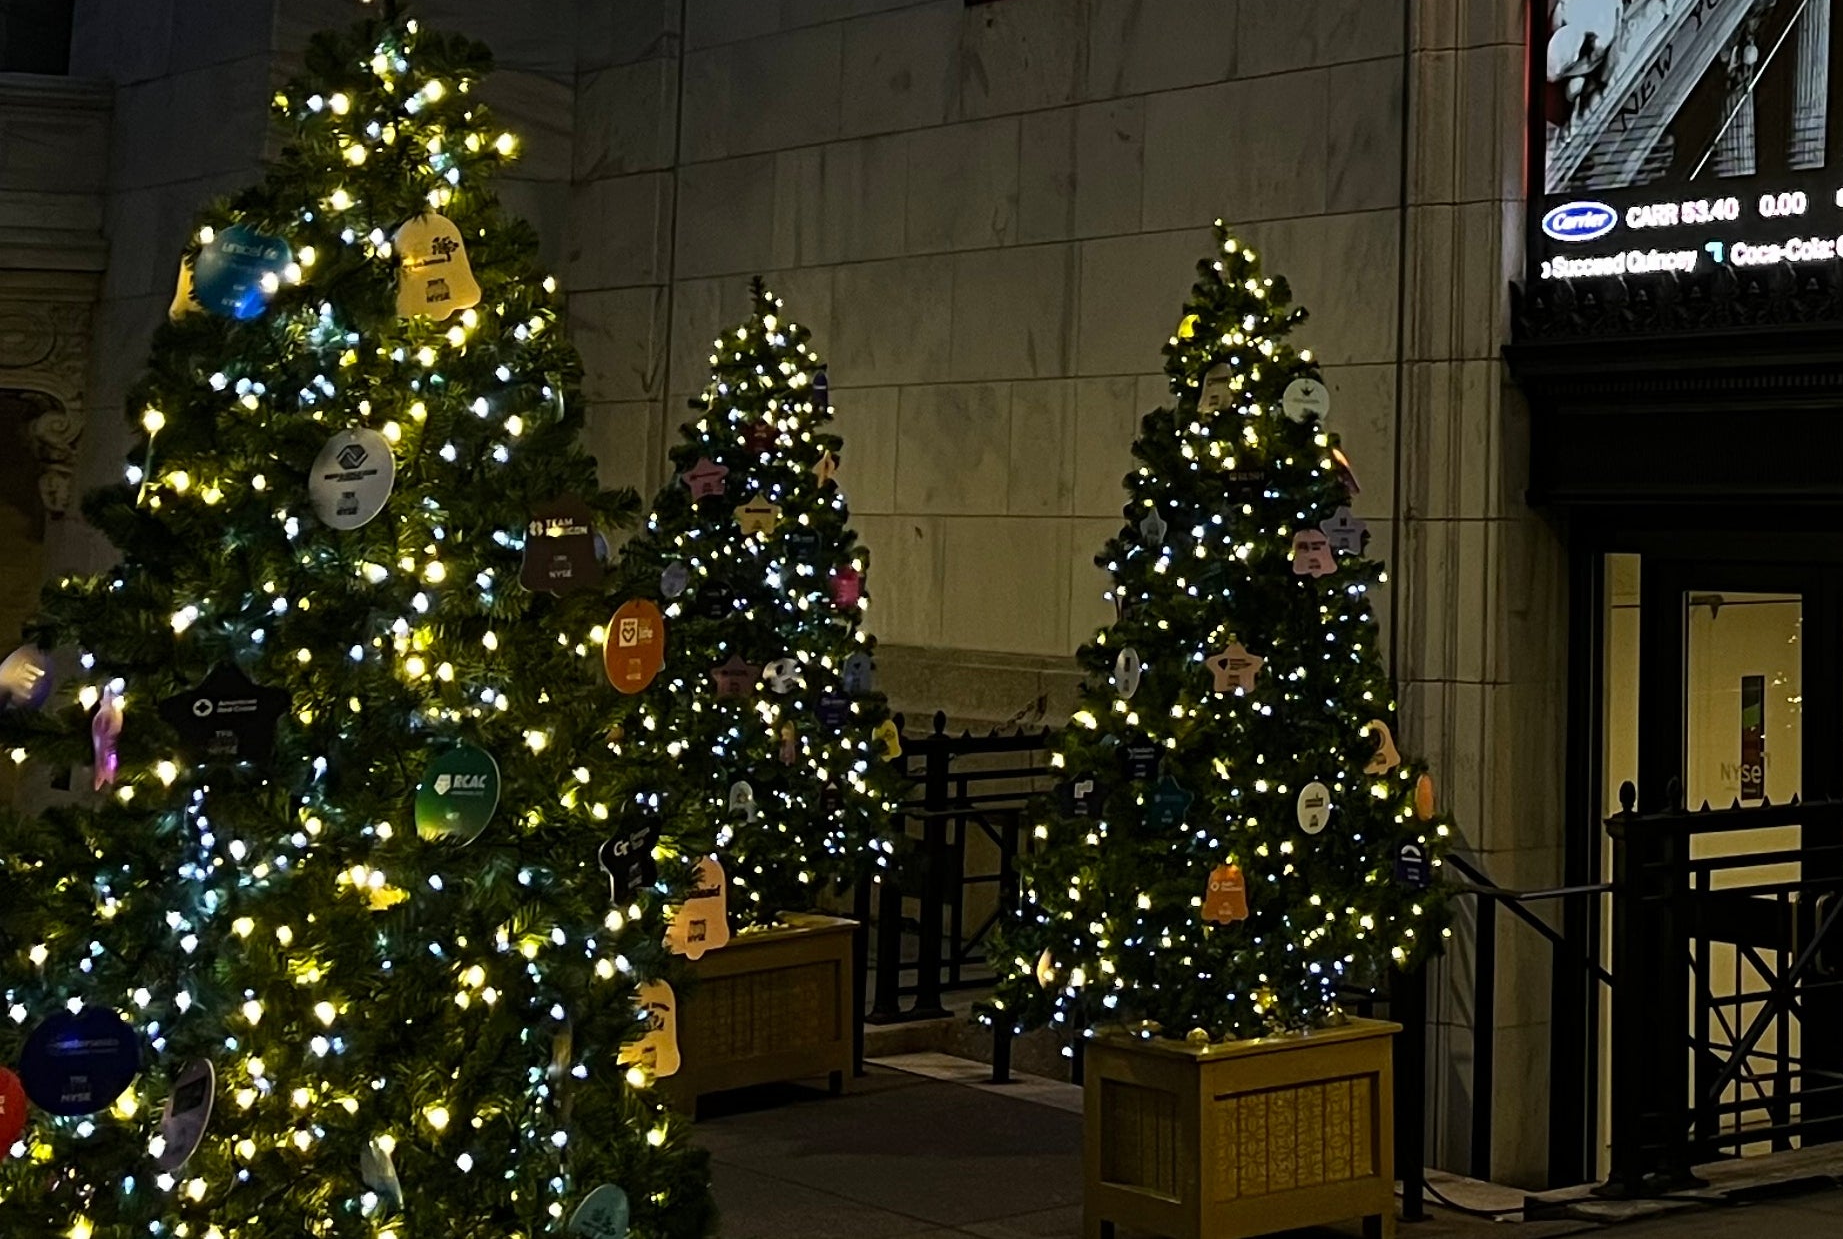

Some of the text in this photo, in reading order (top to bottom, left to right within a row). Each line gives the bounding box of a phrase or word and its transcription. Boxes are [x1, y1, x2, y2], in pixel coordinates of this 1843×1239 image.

[1607, 43, 1673, 133] NEW
[1552, 211, 1610, 232] Carrier
[1625, 202, 1679, 229] CARR
[1680, 197, 1740, 225] 53.40
[1758, 191, 1807, 218] 0.00
[1730, 236, 1835, 267] Coca-Cola:
[545, 518, 574, 528] TEAM
